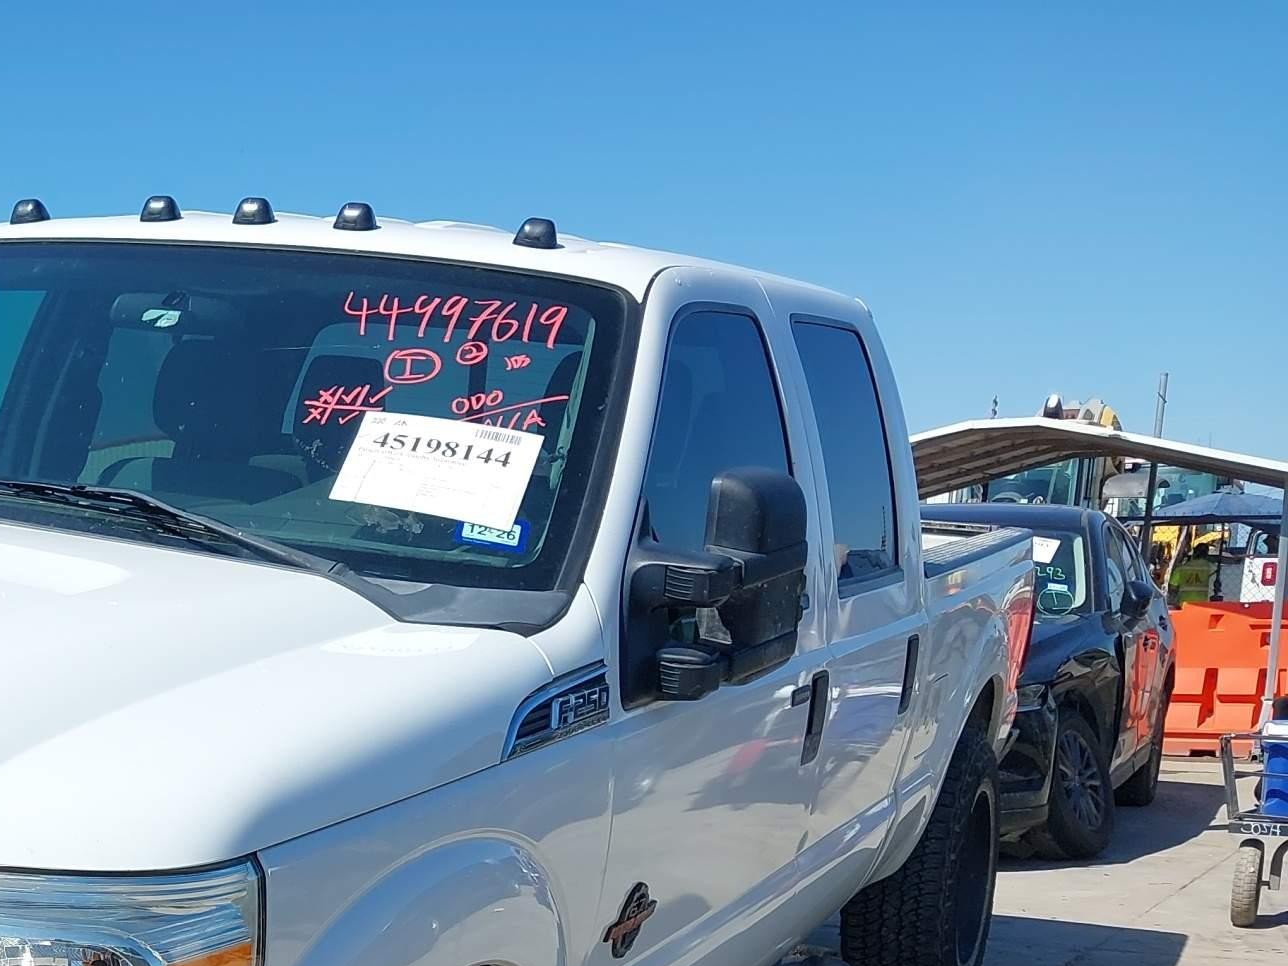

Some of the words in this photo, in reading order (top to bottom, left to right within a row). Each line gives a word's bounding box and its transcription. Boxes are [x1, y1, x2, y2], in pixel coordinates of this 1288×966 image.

[343, 291, 568, 349] 44997619
[452, 390, 504, 414] ODO
[373, 432, 512, 468] 45198144
